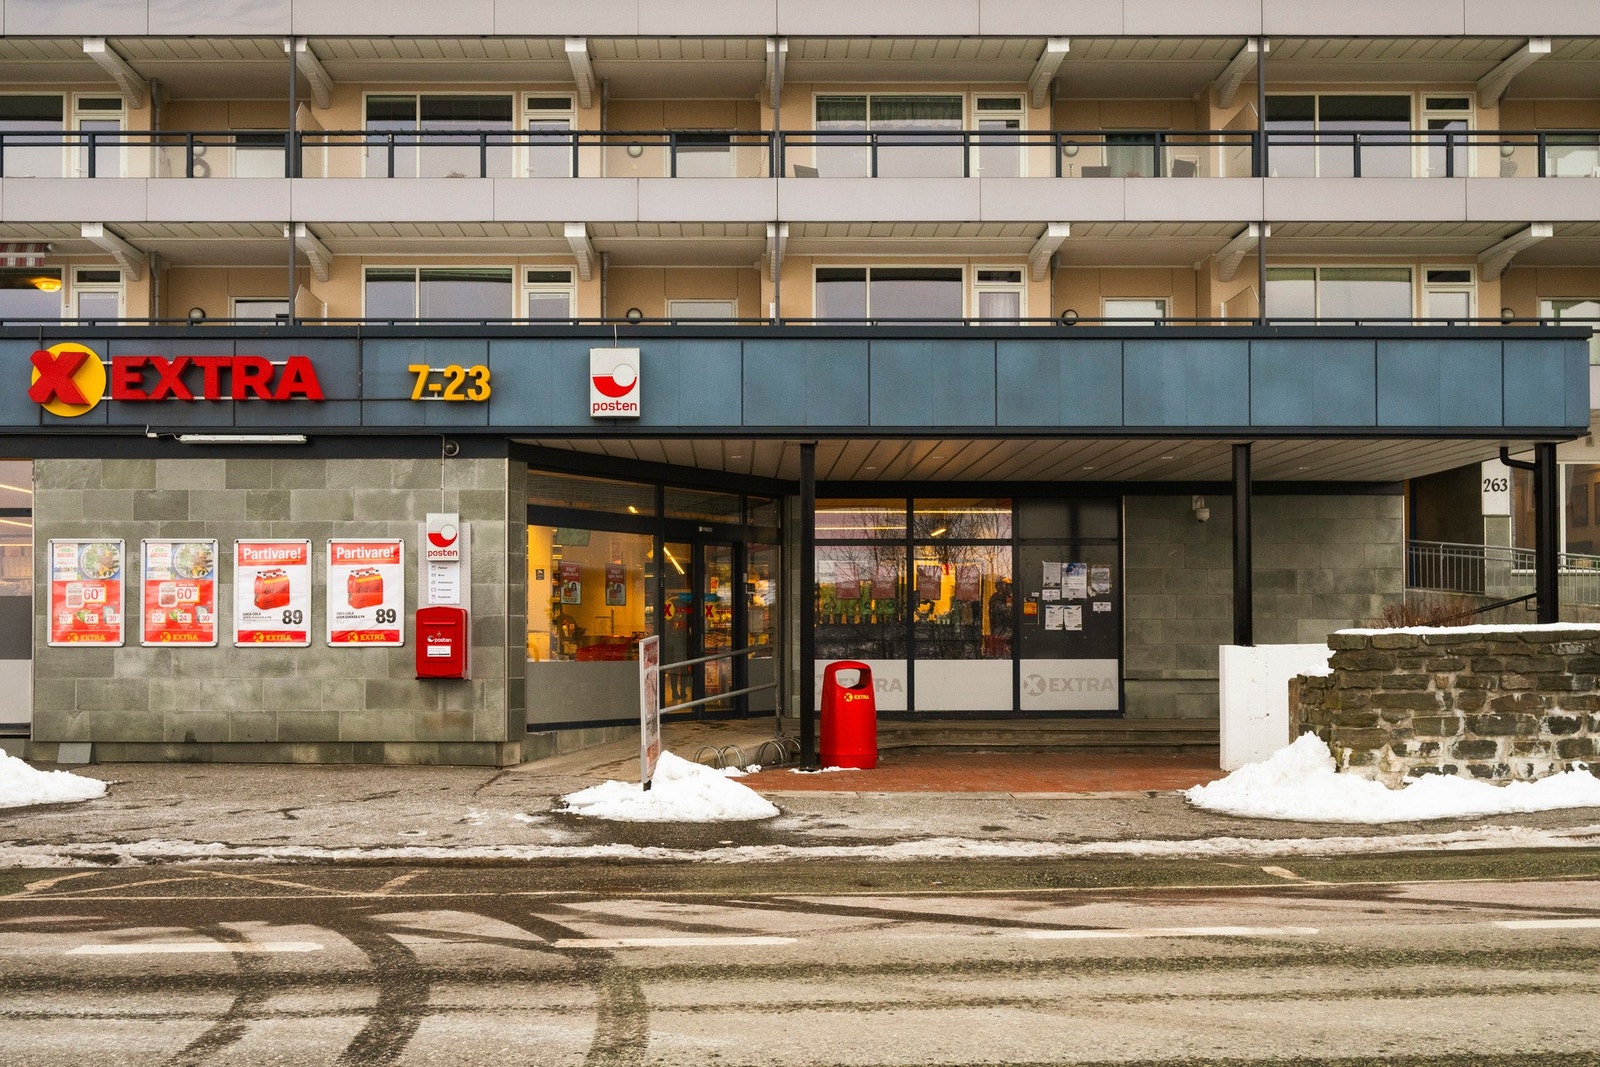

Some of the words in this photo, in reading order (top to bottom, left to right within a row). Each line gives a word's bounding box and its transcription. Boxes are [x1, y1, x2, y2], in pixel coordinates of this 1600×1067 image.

[111, 355, 325, 402] EXTRA
[408, 364, 492, 402] 7-23
[592, 401, 638, 414] posten
[1483, 478, 1508, 492] 263
[243, 546, 301, 560] Partivare!
[336, 545, 395, 559] Partivare!
[427, 549, 458, 558] posten
[282, 609, 303, 625] 89
[375, 608, 397, 624] 89
[173, 633, 199, 641] EXTRA
[360, 633, 386, 641] EXTRA
[1049, 677, 1116, 692] EXTRA
